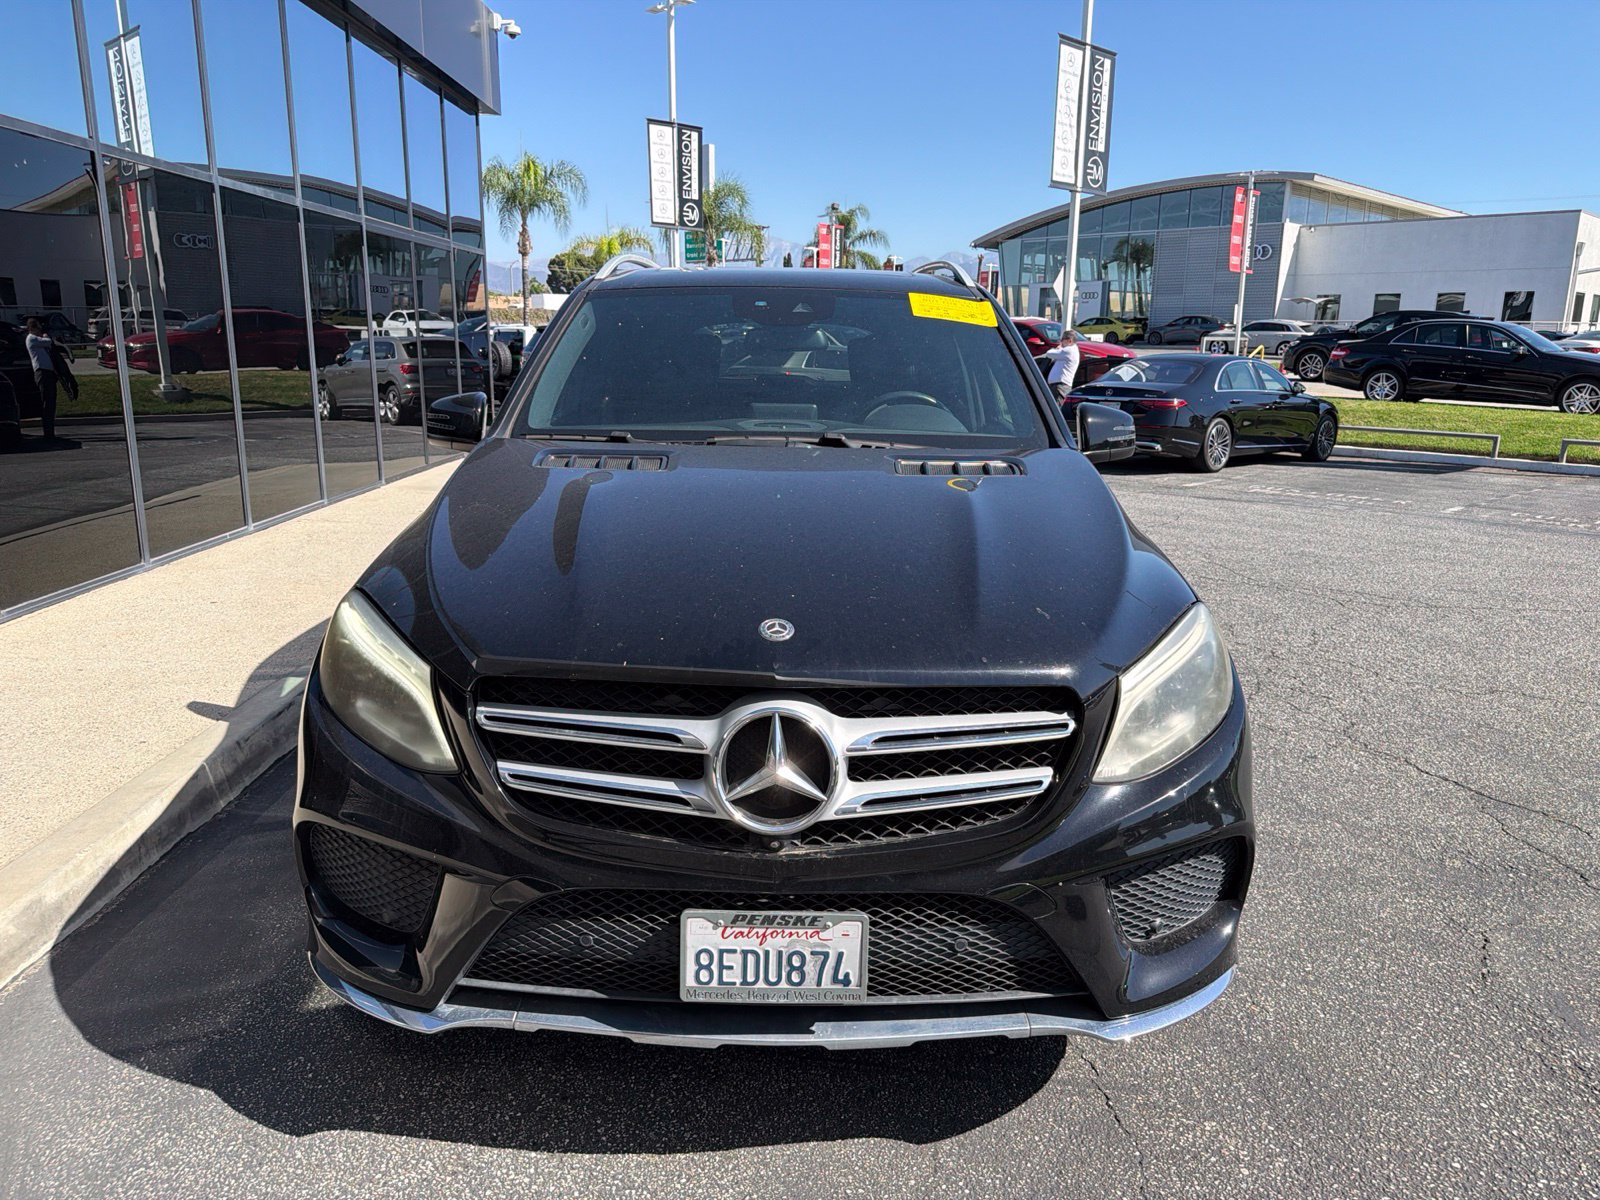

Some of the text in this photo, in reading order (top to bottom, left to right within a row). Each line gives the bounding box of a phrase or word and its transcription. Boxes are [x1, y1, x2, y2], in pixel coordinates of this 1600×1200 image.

[1088, 55, 1105, 151] ENVISION
[681, 129, 692, 199] ENVISION
[730, 913, 824, 927] PENSKE
[720, 926, 833, 946] California
[693, 948, 853, 988] 8EDU874
[685, 988, 744, 1000] Mercedes
[778, 991, 790, 1001] of
[792, 990, 821, 1001] West
[823, 990, 861, 1001] Covina
